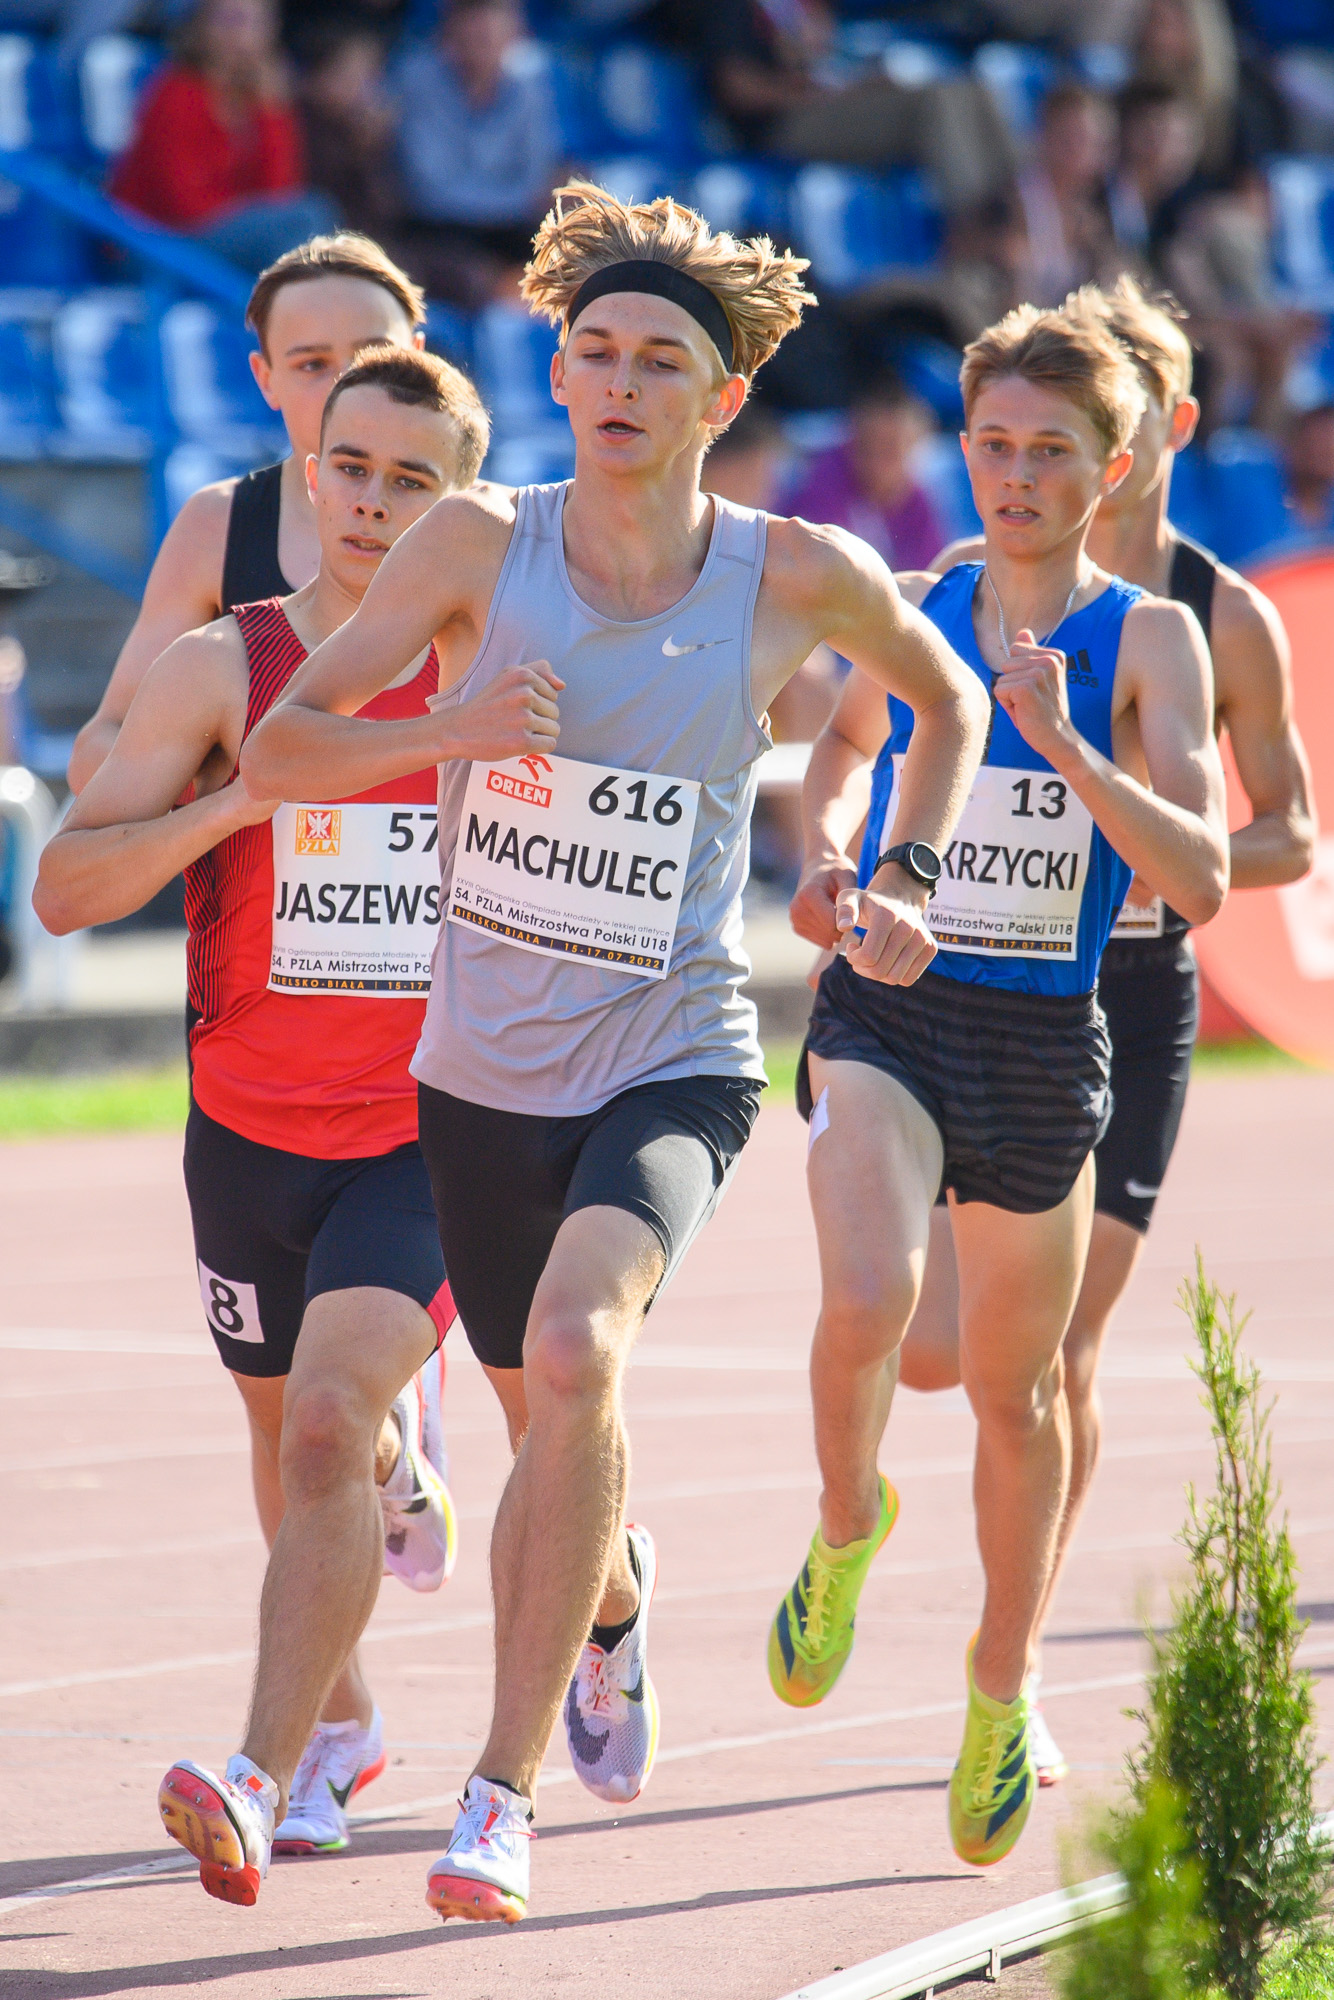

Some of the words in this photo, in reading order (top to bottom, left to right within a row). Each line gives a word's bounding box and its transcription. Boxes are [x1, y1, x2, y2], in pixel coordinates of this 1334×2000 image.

[489, 774, 549, 807] ORLEN
[588, 775, 683, 827] 616
[1011, 778, 1068, 820] 13
[297, 840, 337, 854] PZLA
[388, 811, 438, 853] 57
[465, 812, 679, 902] MACHULEC
[275, 881, 441, 926] JASZEWS
[454, 887, 472, 904] 54.
[475, 894, 504, 916] PZLA
[507, 907, 589, 938] Mistrzostwa
[594, 928, 637, 947] Polski
[640, 936, 668, 952] U18
[475, 884, 520, 906] Ogólnopolska
[521, 900, 561, 917] Olimpiada
[562, 911, 602, 926] Młodzieży
[611, 920, 636, 932] lekkiej
[637, 925, 670, 937] atletyce
[928, 912, 1003, 933] Mistrzostwa
[1007, 922, 1046, 936] Polski
[1049, 923, 1073, 936] U18
[341, 950, 380, 959] Olimpiada
[455, 907, 540, 945] BIELSKO-BIAŁA
[564, 942, 660, 969] 15-17.07.2022
[272, 974, 365, 990] BIELSKO-BIAŁA
[290, 957, 323, 971] PZLA
[327, 960, 409, 973] Mistrzostwa
[208, 1277, 244, 1334] 8
